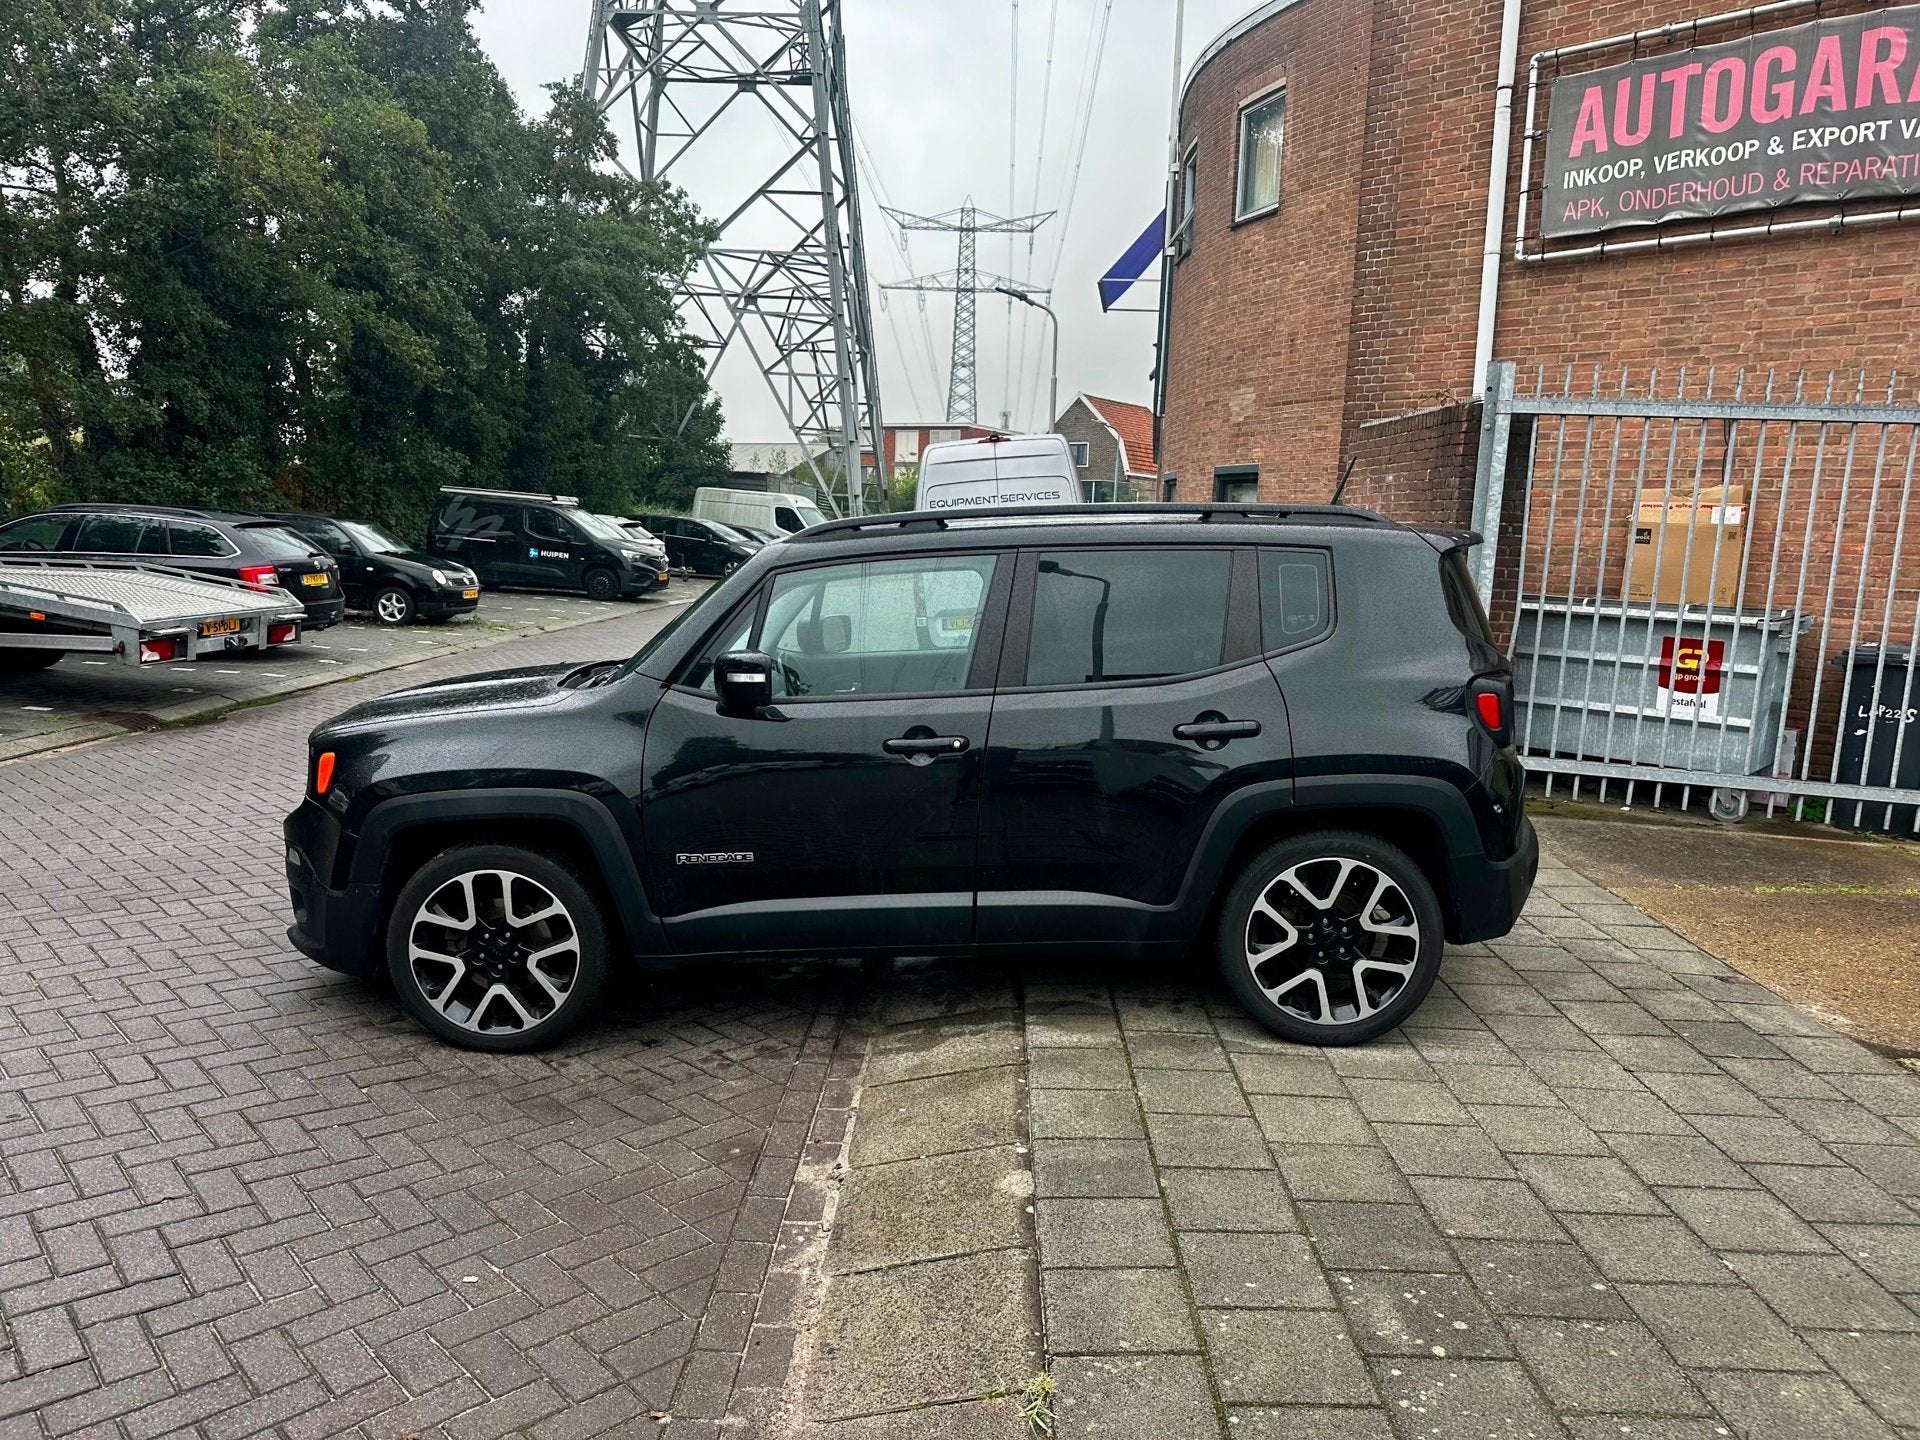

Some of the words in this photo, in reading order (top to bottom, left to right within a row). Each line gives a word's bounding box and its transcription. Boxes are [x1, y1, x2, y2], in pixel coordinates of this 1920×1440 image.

[1563, 158, 1646, 190] INKOOP,
[1653, 139, 1760, 174] VERKOOP
[1766, 135, 1785, 156] &
[1792, 120, 1893, 151] EXPORT
[1900, 117, 1920, 140] V
[1562, 196, 1610, 222] APK,
[1618, 171, 1764, 212] ONDERHOUD
[1772, 168, 1791, 191] &
[1799, 153, 1920, 186] REPARATI
[929, 495, 998, 509] EQUIPMENT
[1000, 490, 1061, 503] SERVICES
[540, 550, 570, 559] HUIPEN
[1684, 674, 1706, 682] grot
[676, 852, 754, 865] RENEGADE
